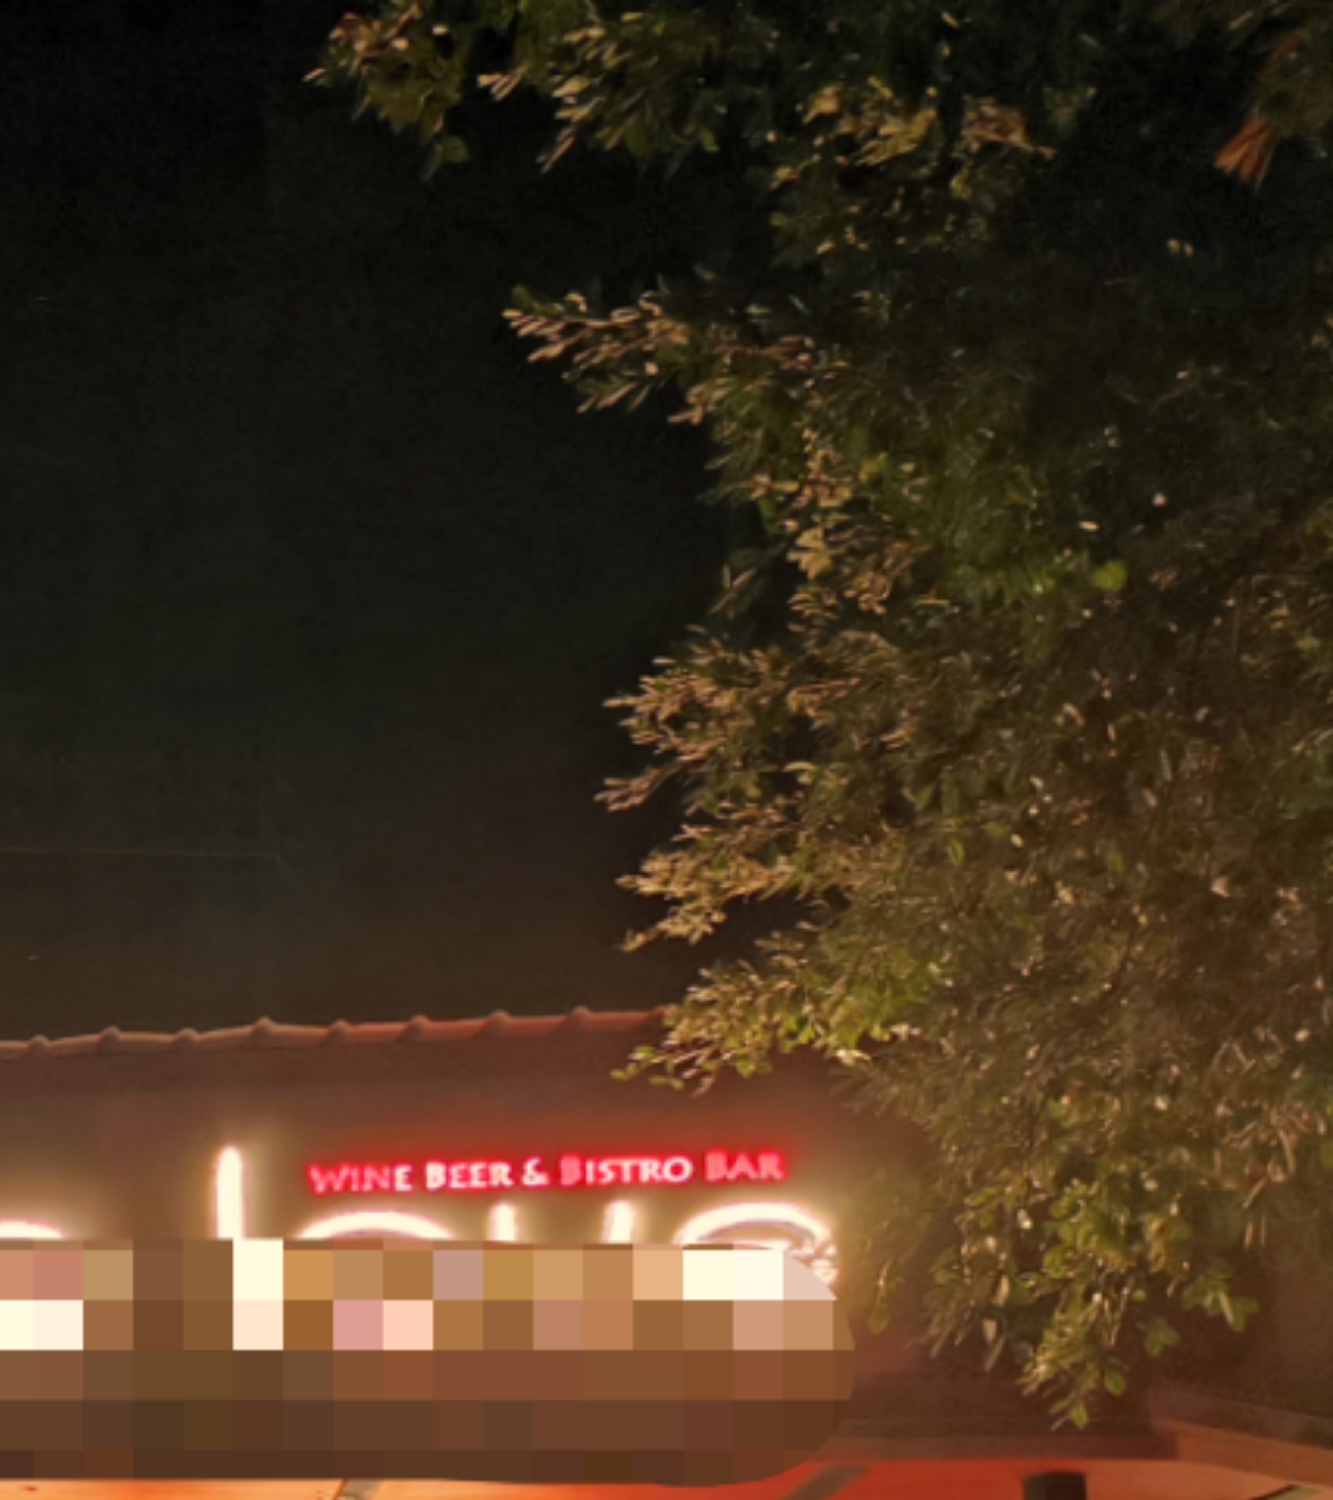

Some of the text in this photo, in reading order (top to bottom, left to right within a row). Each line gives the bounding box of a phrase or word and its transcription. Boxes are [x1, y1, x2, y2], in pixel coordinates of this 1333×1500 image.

[307, 1150, 787, 1195] WINE BEER & BISTRO BAR
